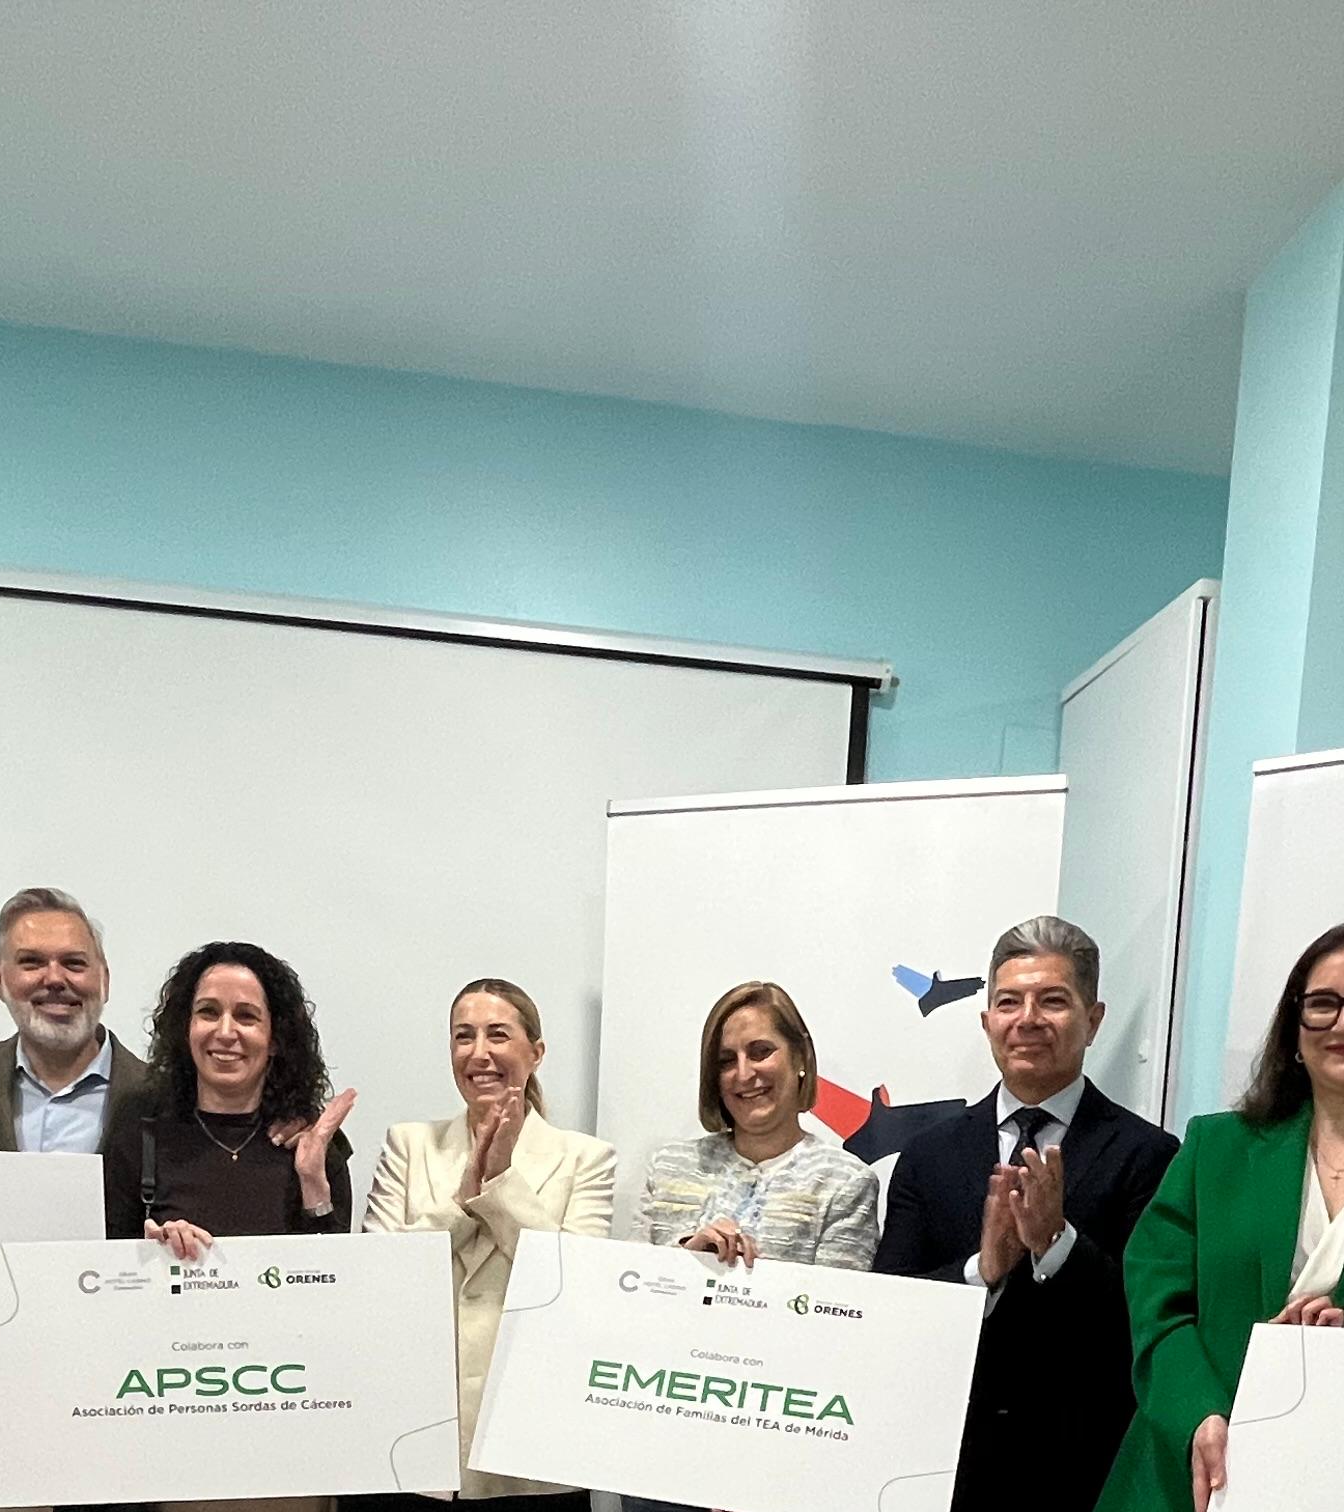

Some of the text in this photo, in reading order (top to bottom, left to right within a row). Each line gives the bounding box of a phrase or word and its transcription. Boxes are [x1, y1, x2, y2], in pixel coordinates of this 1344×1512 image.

[209, 1268, 220, 1278] DE
[285, 1273, 337, 1285] ORENES
[813, 1304, 864, 1320] ORENES
[171, 1340, 249, 1352] Colabora con
[689, 1348, 764, 1368] Colabora con
[115, 1364, 307, 1400] APSCC
[588, 1359, 855, 1426] EMERITEA
[71, 1397, 353, 1418] Asociación de Personas Sordas de Cáceres
[584, 1393, 850, 1442] Asociación de Familias del TEA de Mérida
